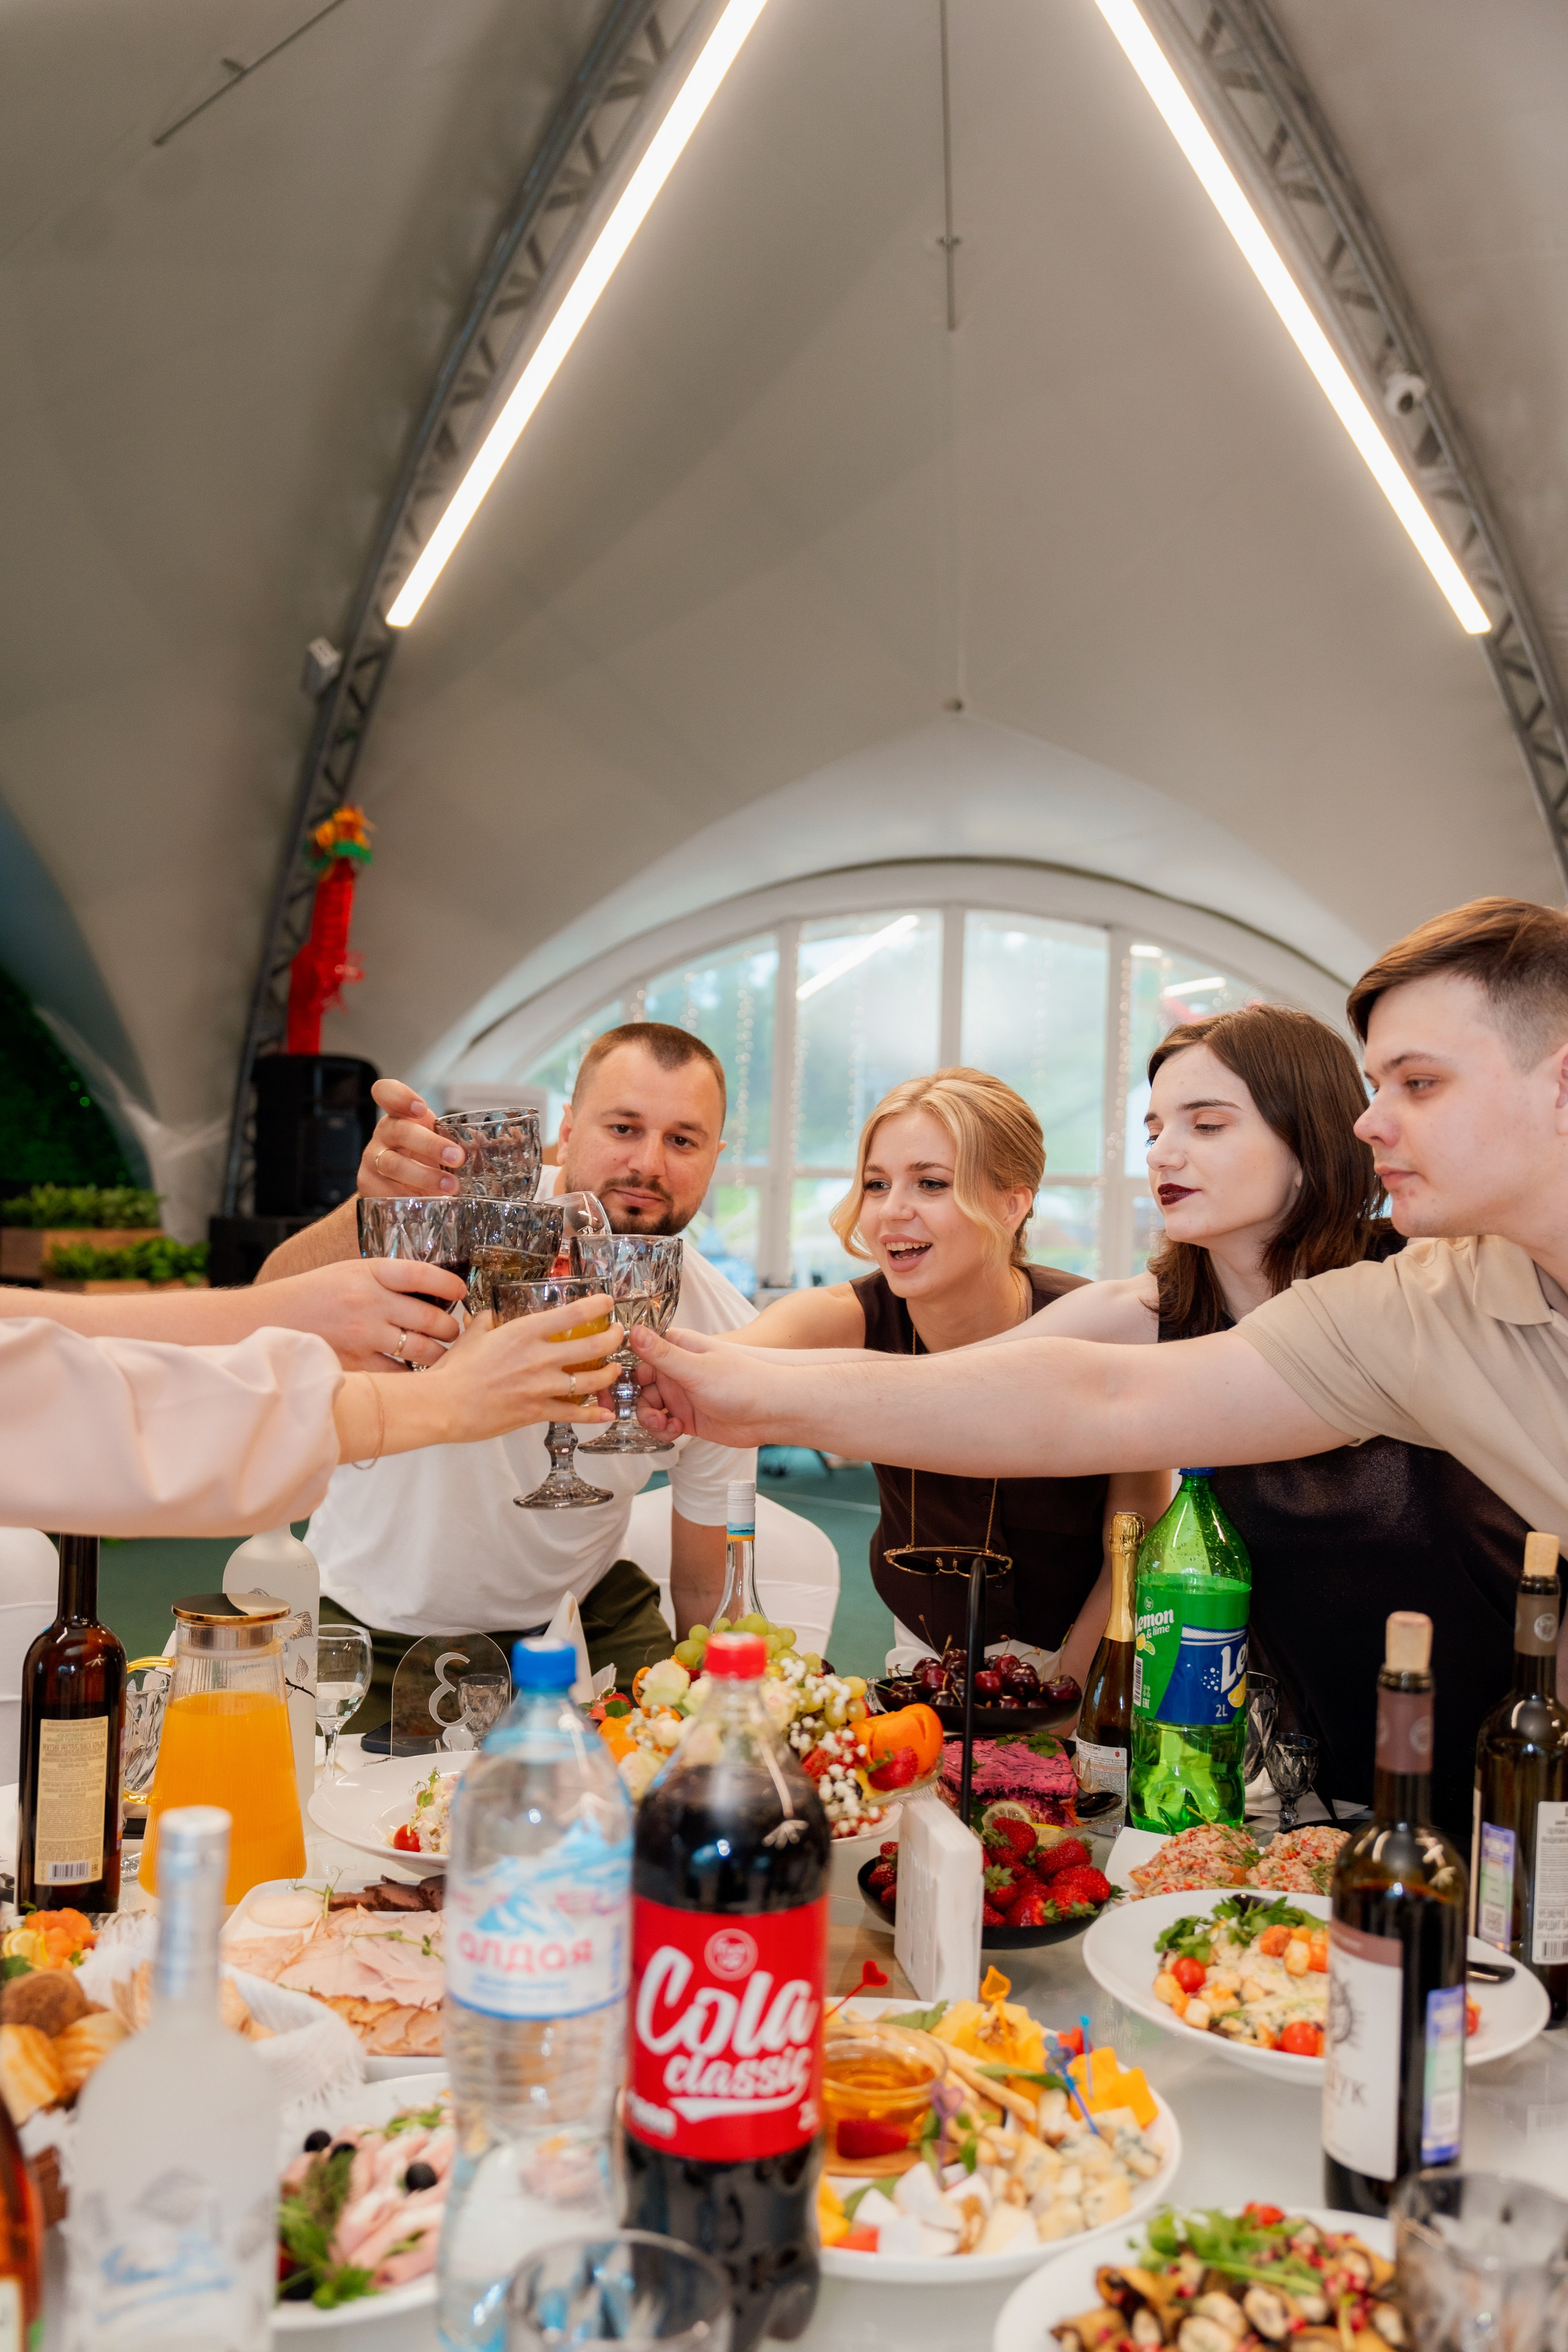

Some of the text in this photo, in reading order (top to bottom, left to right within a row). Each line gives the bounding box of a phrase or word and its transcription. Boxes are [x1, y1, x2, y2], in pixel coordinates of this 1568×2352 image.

[1153, 1625, 1170, 1636] lime
[1215, 1704, 1227, 1717] 2L
[636, 1945, 820, 2057] Cola
